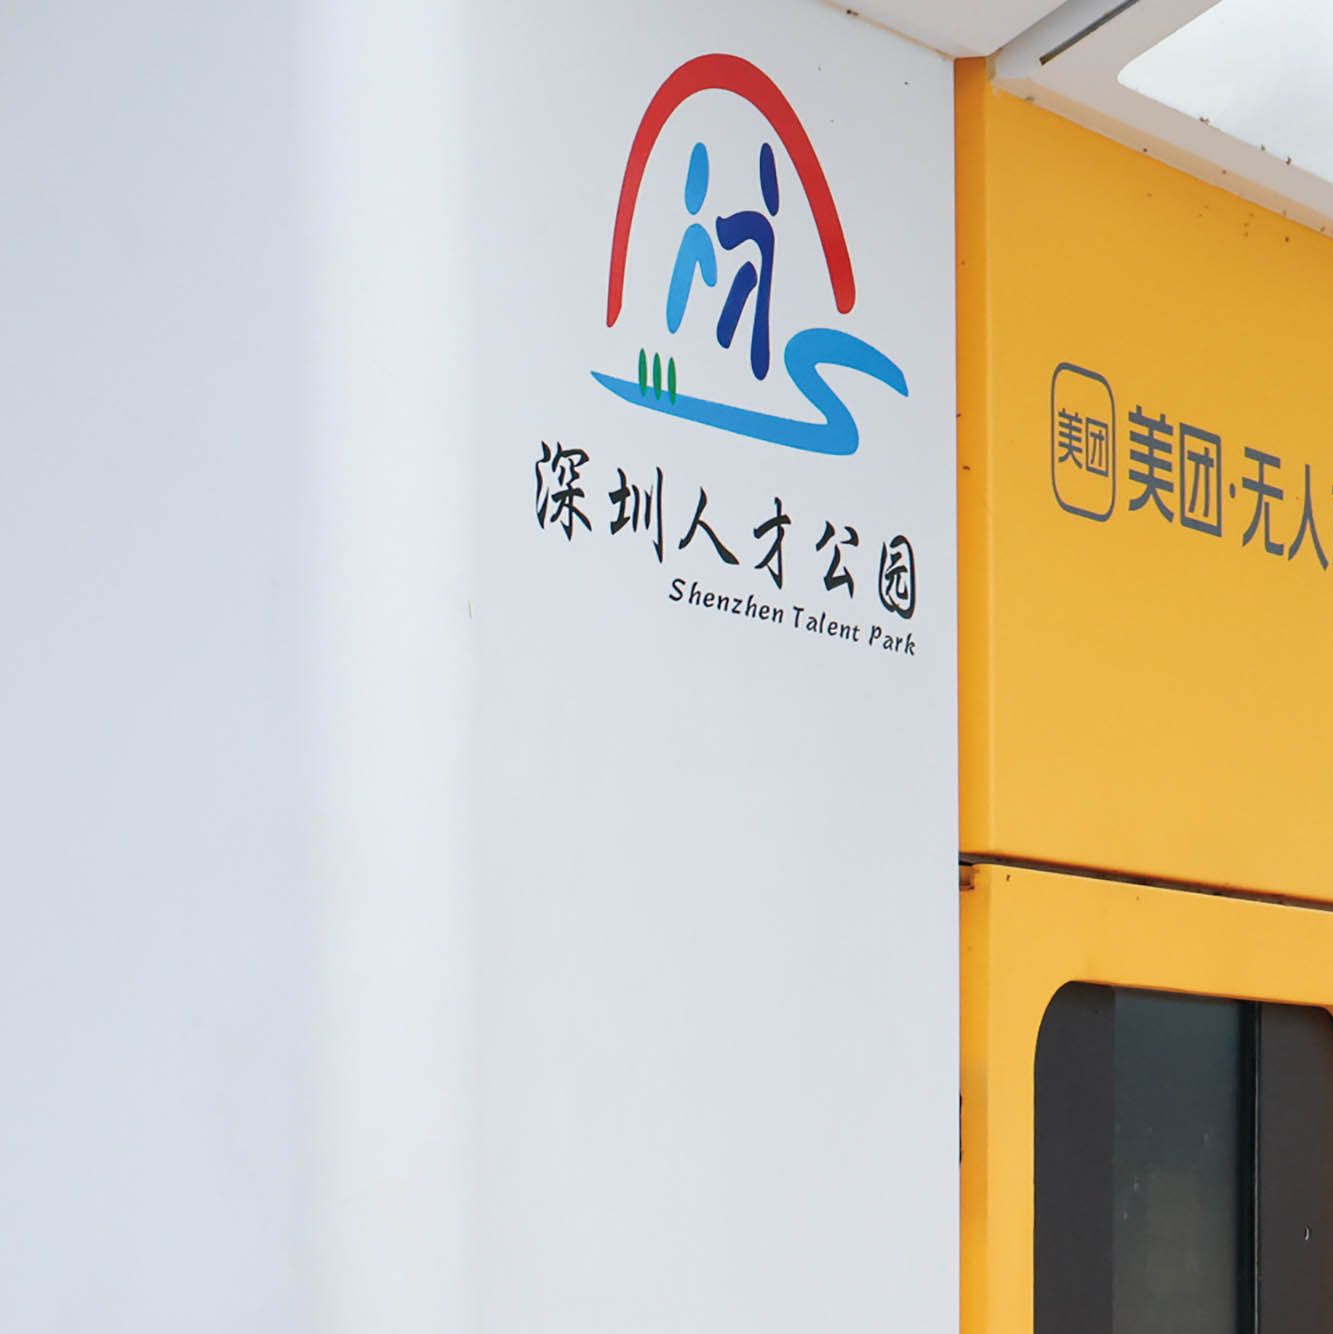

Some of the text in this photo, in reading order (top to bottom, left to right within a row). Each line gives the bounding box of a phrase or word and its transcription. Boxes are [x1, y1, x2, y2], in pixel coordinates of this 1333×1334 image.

[1058, 408, 1109, 477] 美团
[534, 440, 917, 620] 深圳人才公园
[669, 578, 917, 656] Shenzhen Talent Park
